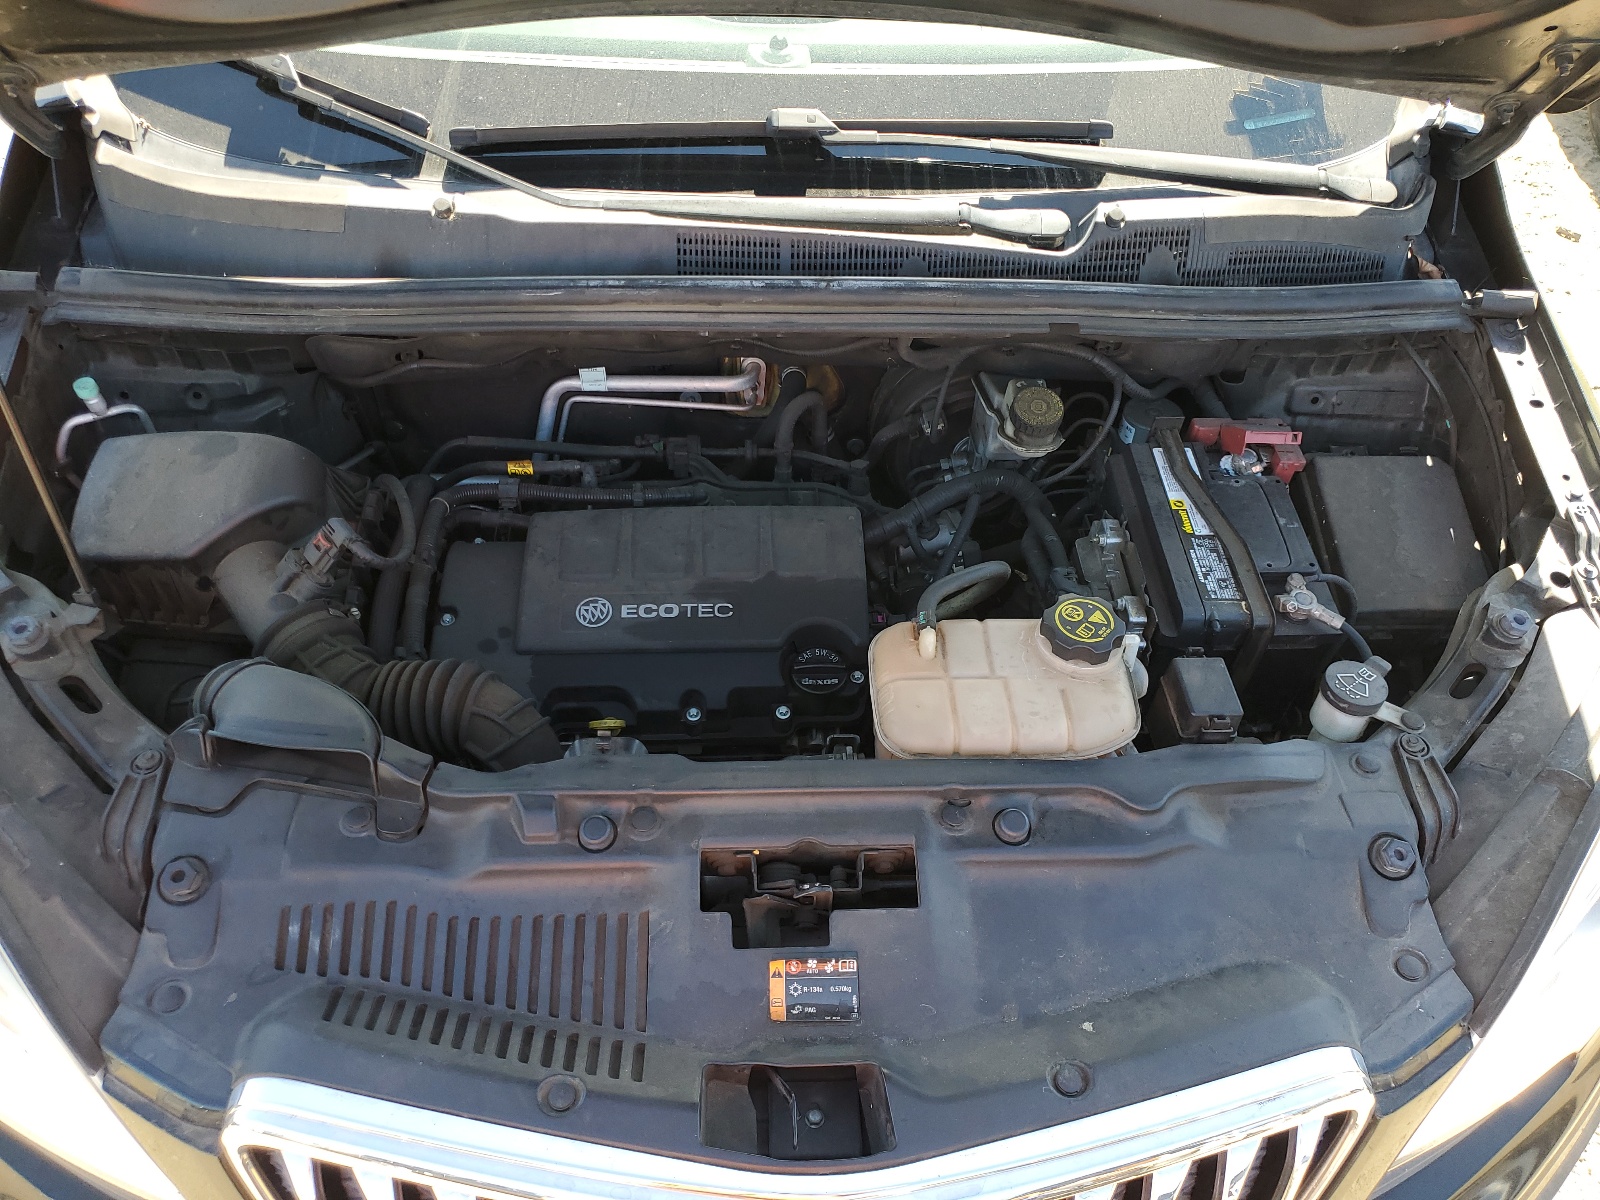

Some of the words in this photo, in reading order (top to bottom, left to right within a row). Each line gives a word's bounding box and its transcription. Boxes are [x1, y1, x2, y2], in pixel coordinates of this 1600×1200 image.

[620, 603, 734, 618] ECOTEC
[798, 650, 813, 663] SAE
[815, 648, 839, 663] 5W-30
